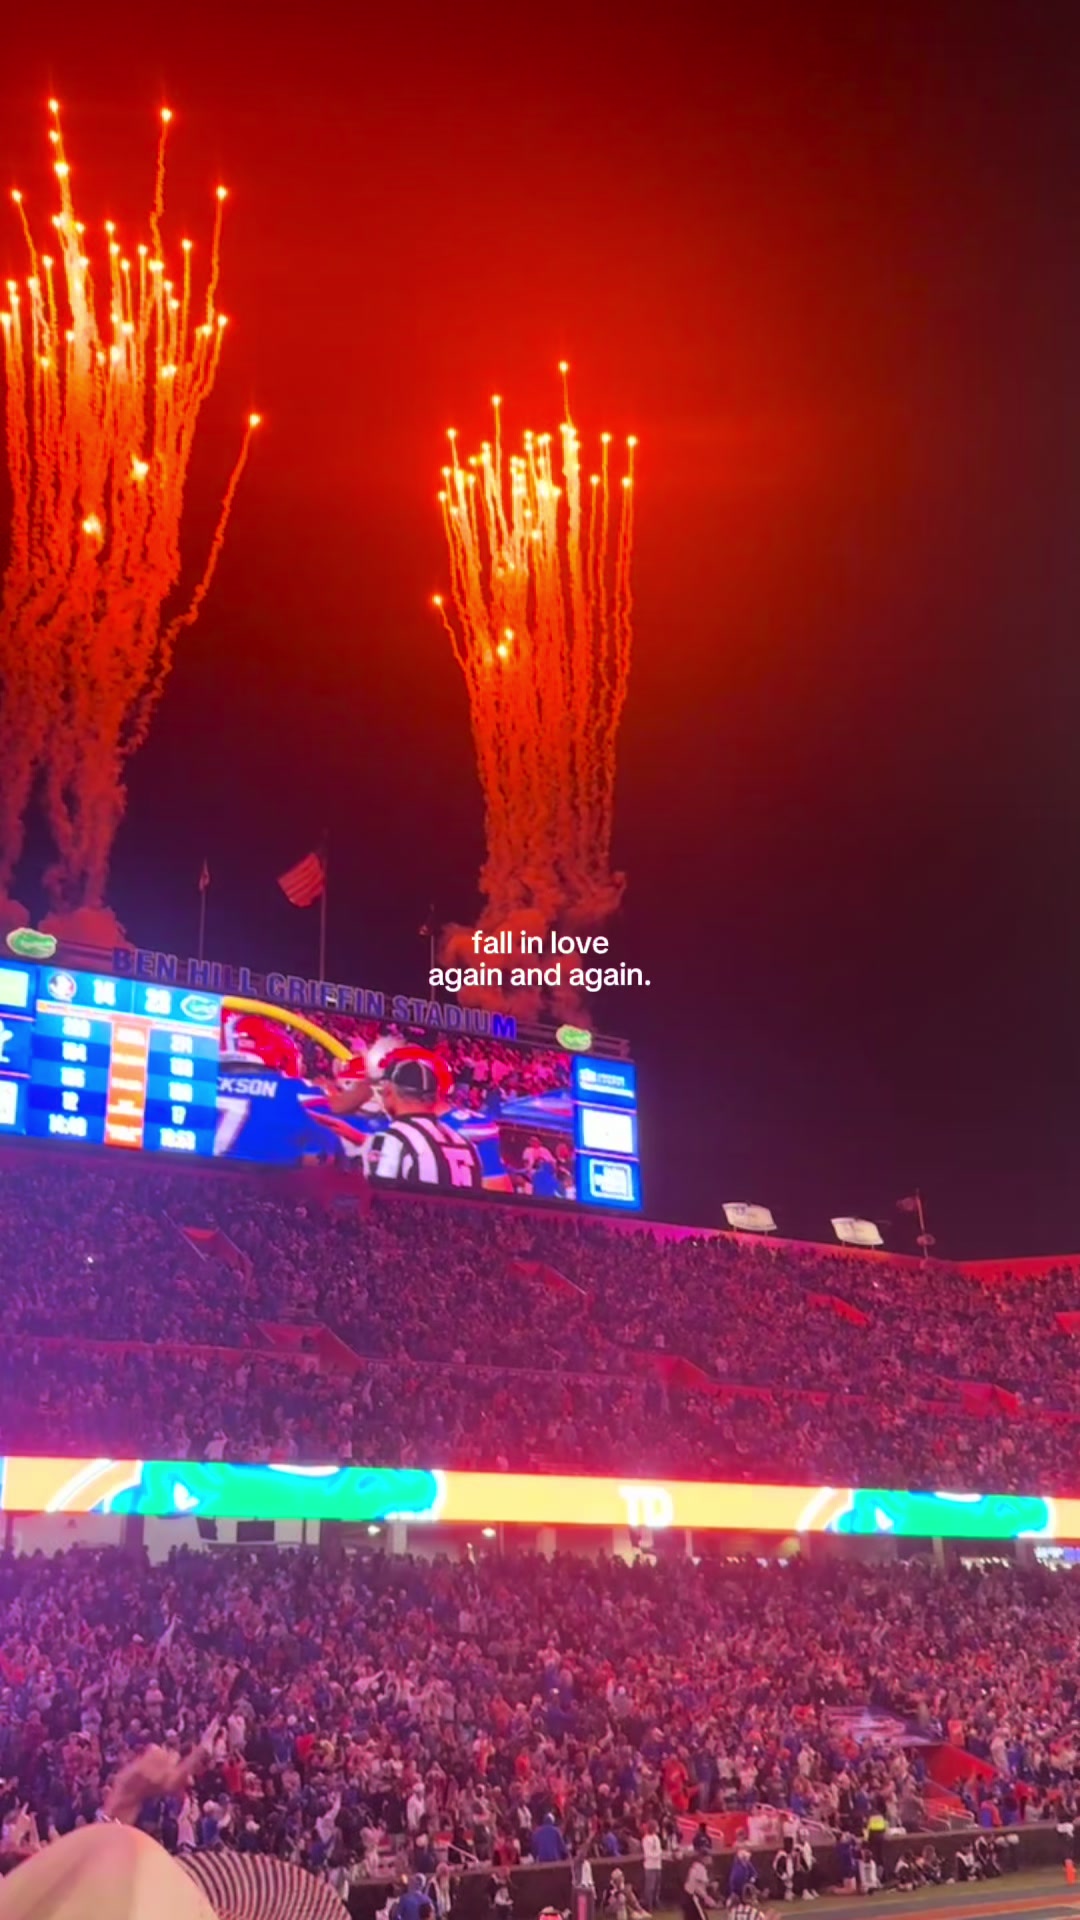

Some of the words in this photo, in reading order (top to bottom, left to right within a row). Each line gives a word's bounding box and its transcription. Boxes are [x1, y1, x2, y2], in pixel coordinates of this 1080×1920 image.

[112, 947, 178, 979] BEN
[187, 958, 257, 996] HILL
[266, 971, 385, 1018] GRIFFIN
[391, 994, 518, 1041] STADIUM
